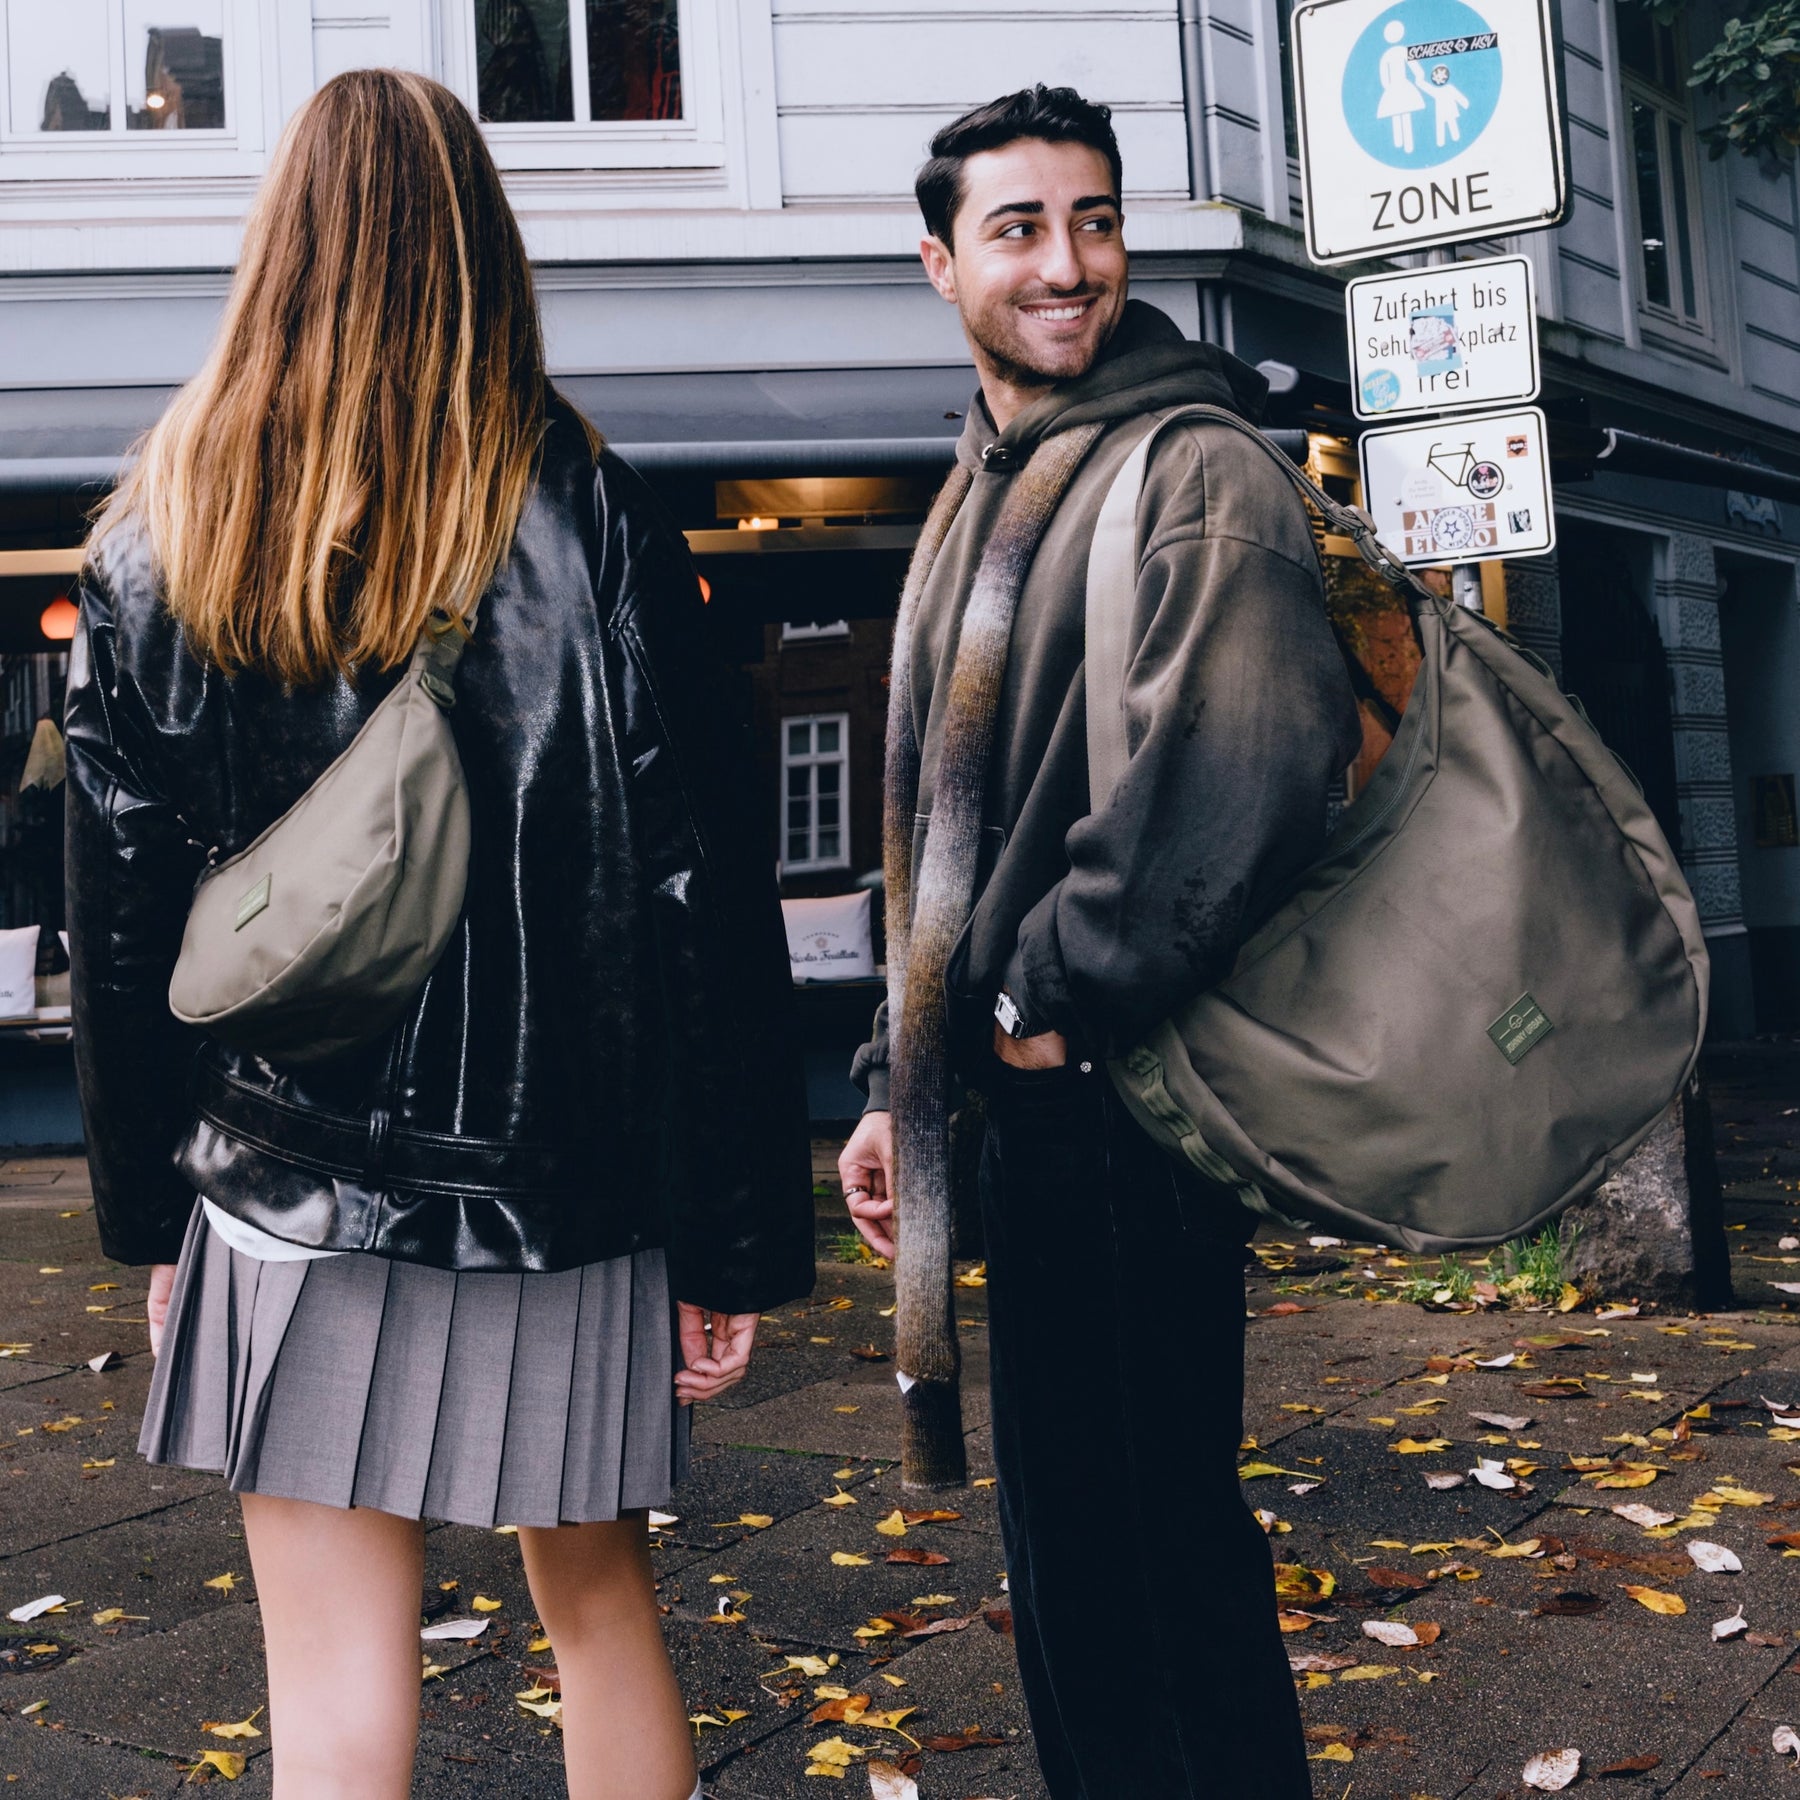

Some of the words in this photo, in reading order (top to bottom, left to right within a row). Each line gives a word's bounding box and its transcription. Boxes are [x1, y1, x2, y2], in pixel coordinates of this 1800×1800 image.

[1408, 41, 1455, 60] SCHEISS
[1470, 34, 1497, 50] HSV
[1370, 171, 1493, 231] ZONE
[1373, 288, 1458, 322] Zufahrt
[1472, 281, 1507, 309] bis
